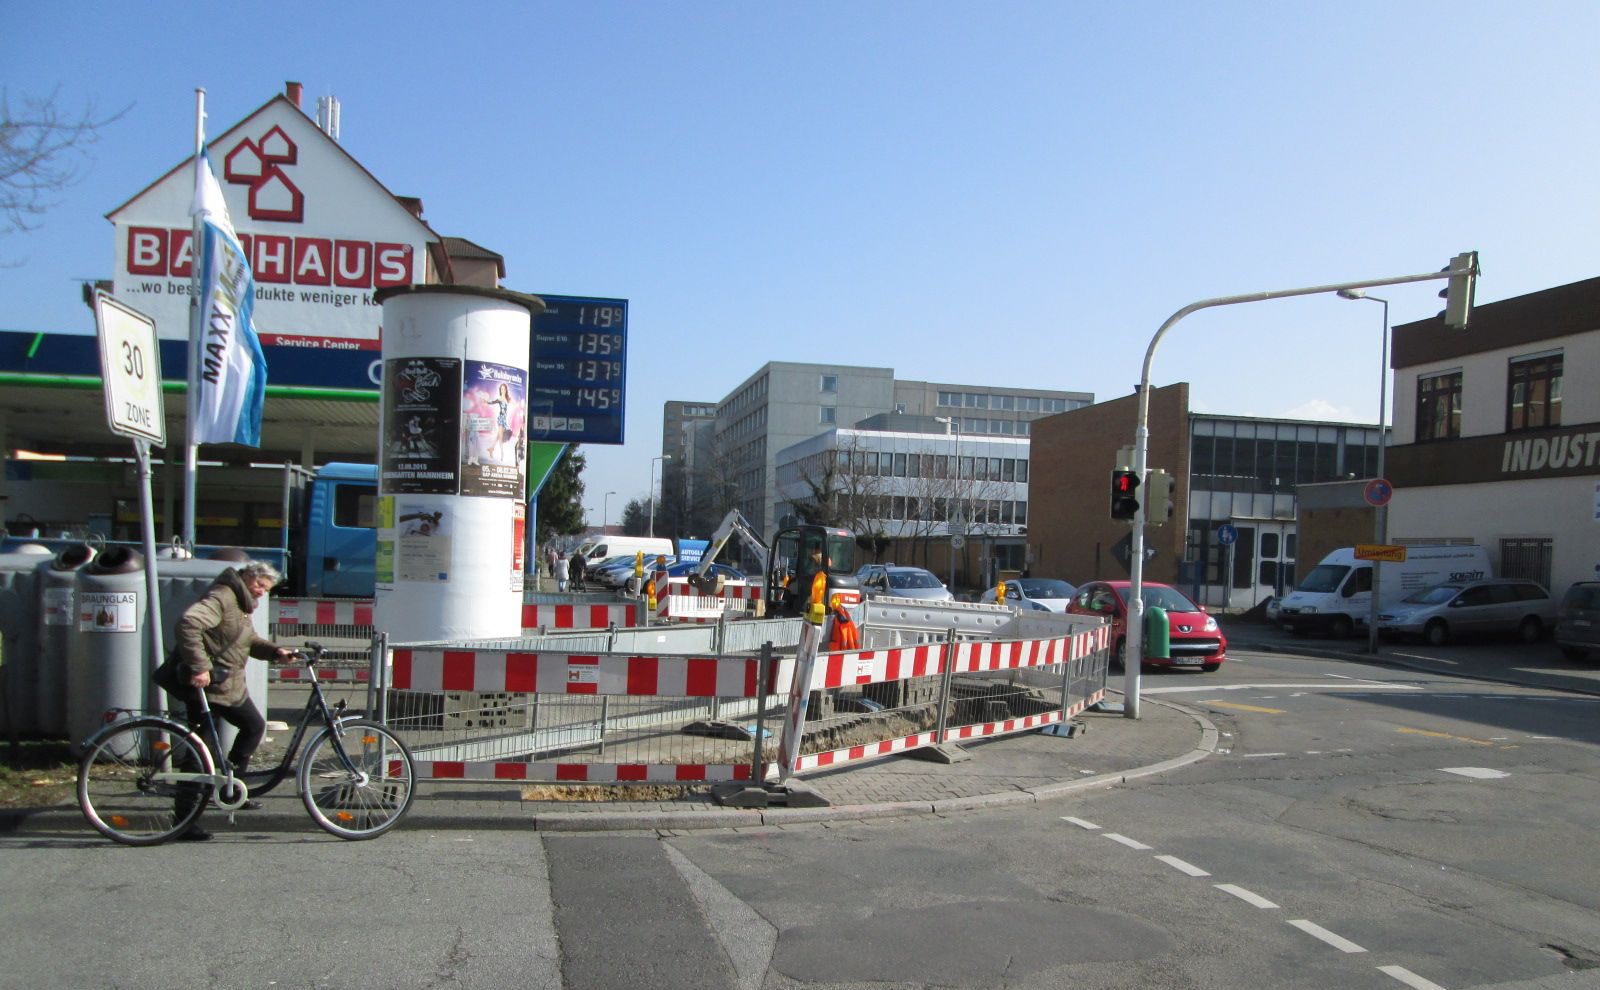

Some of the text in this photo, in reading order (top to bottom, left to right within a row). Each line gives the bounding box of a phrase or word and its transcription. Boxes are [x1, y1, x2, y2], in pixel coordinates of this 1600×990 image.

[133, 232, 407, 281] BAHAUS
[255, 286, 295, 302] dukte
[300, 290, 358, 308] weniger
[276, 336, 361, 350] Service Center
[122, 340, 144, 380] 30
[126, 402, 152, 428] ZONE
[1501, 432, 1600, 473] INDUST
[416, 471, 454, 480] MANNHEIM
[681, 548, 704, 556] AUTOGLA
